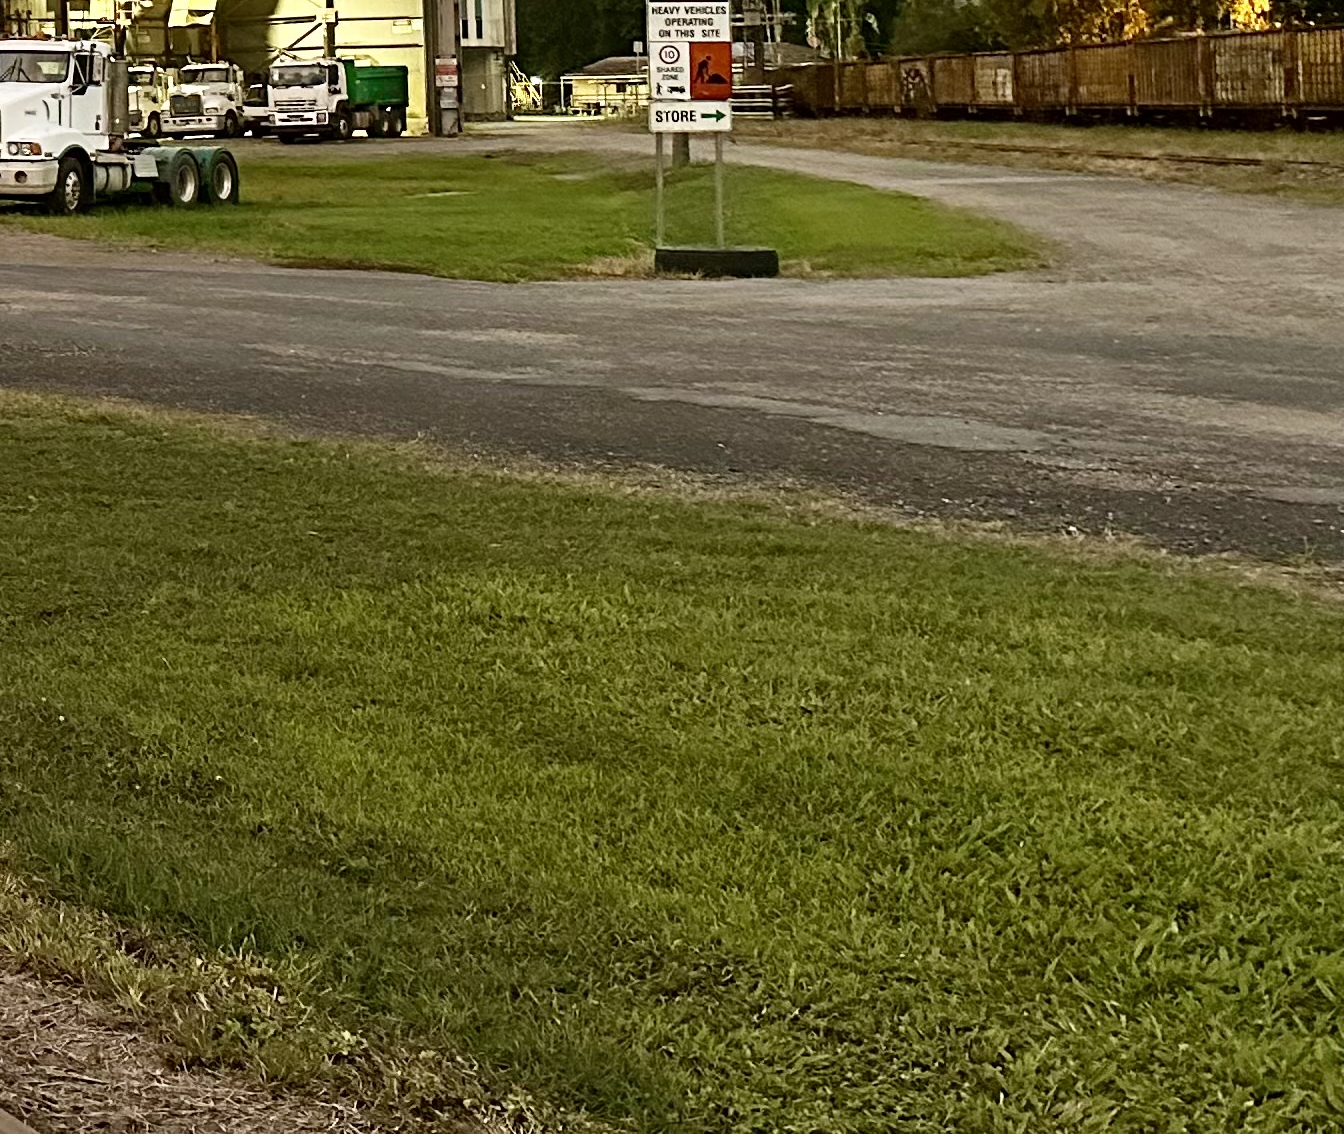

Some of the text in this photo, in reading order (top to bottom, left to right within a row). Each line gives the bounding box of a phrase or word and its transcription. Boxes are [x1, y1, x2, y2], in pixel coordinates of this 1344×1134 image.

[651, 6, 727, 15] HEAVY VEHICLES
[664, 17, 714, 26] OPERATING
[658, 29, 721, 38] ON THIS SITE
[664, 50, 675, 59] 10
[655, 110, 697, 123] STORE
